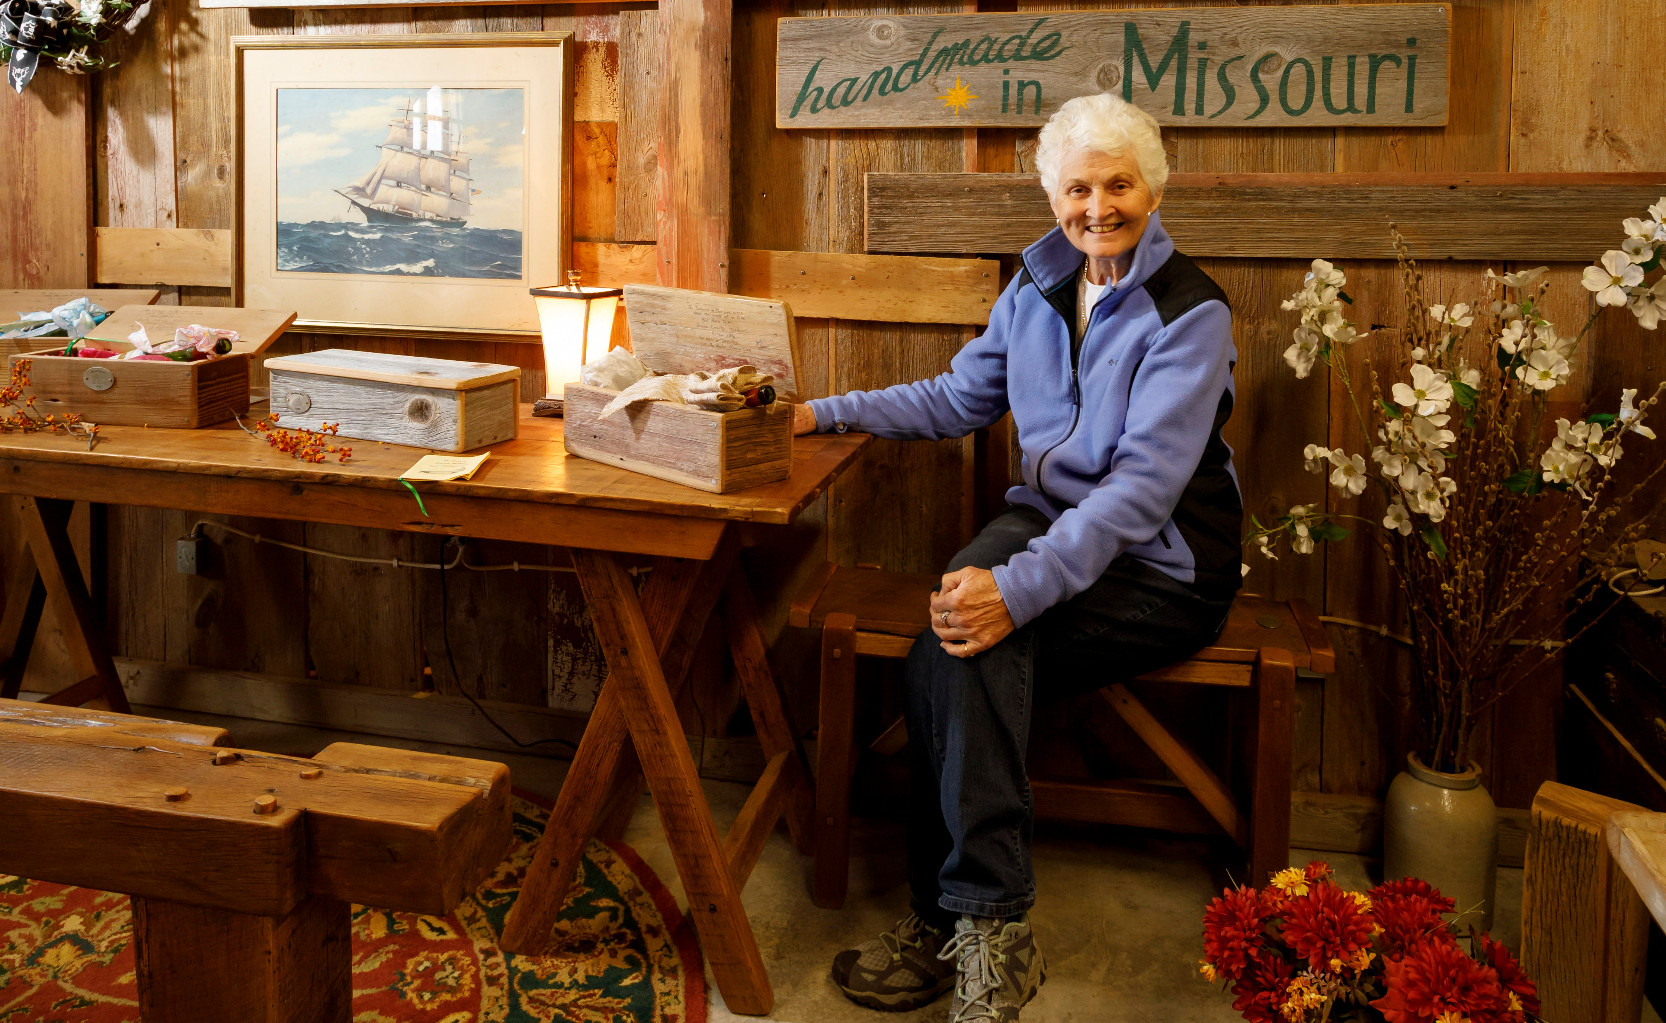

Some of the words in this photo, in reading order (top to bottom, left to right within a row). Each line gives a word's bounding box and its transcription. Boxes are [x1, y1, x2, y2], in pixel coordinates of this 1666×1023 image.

[788, 17, 1070, 119] handmade
[1001, 69, 1042, 116] in
[1123, 20, 1418, 120] Missouri
